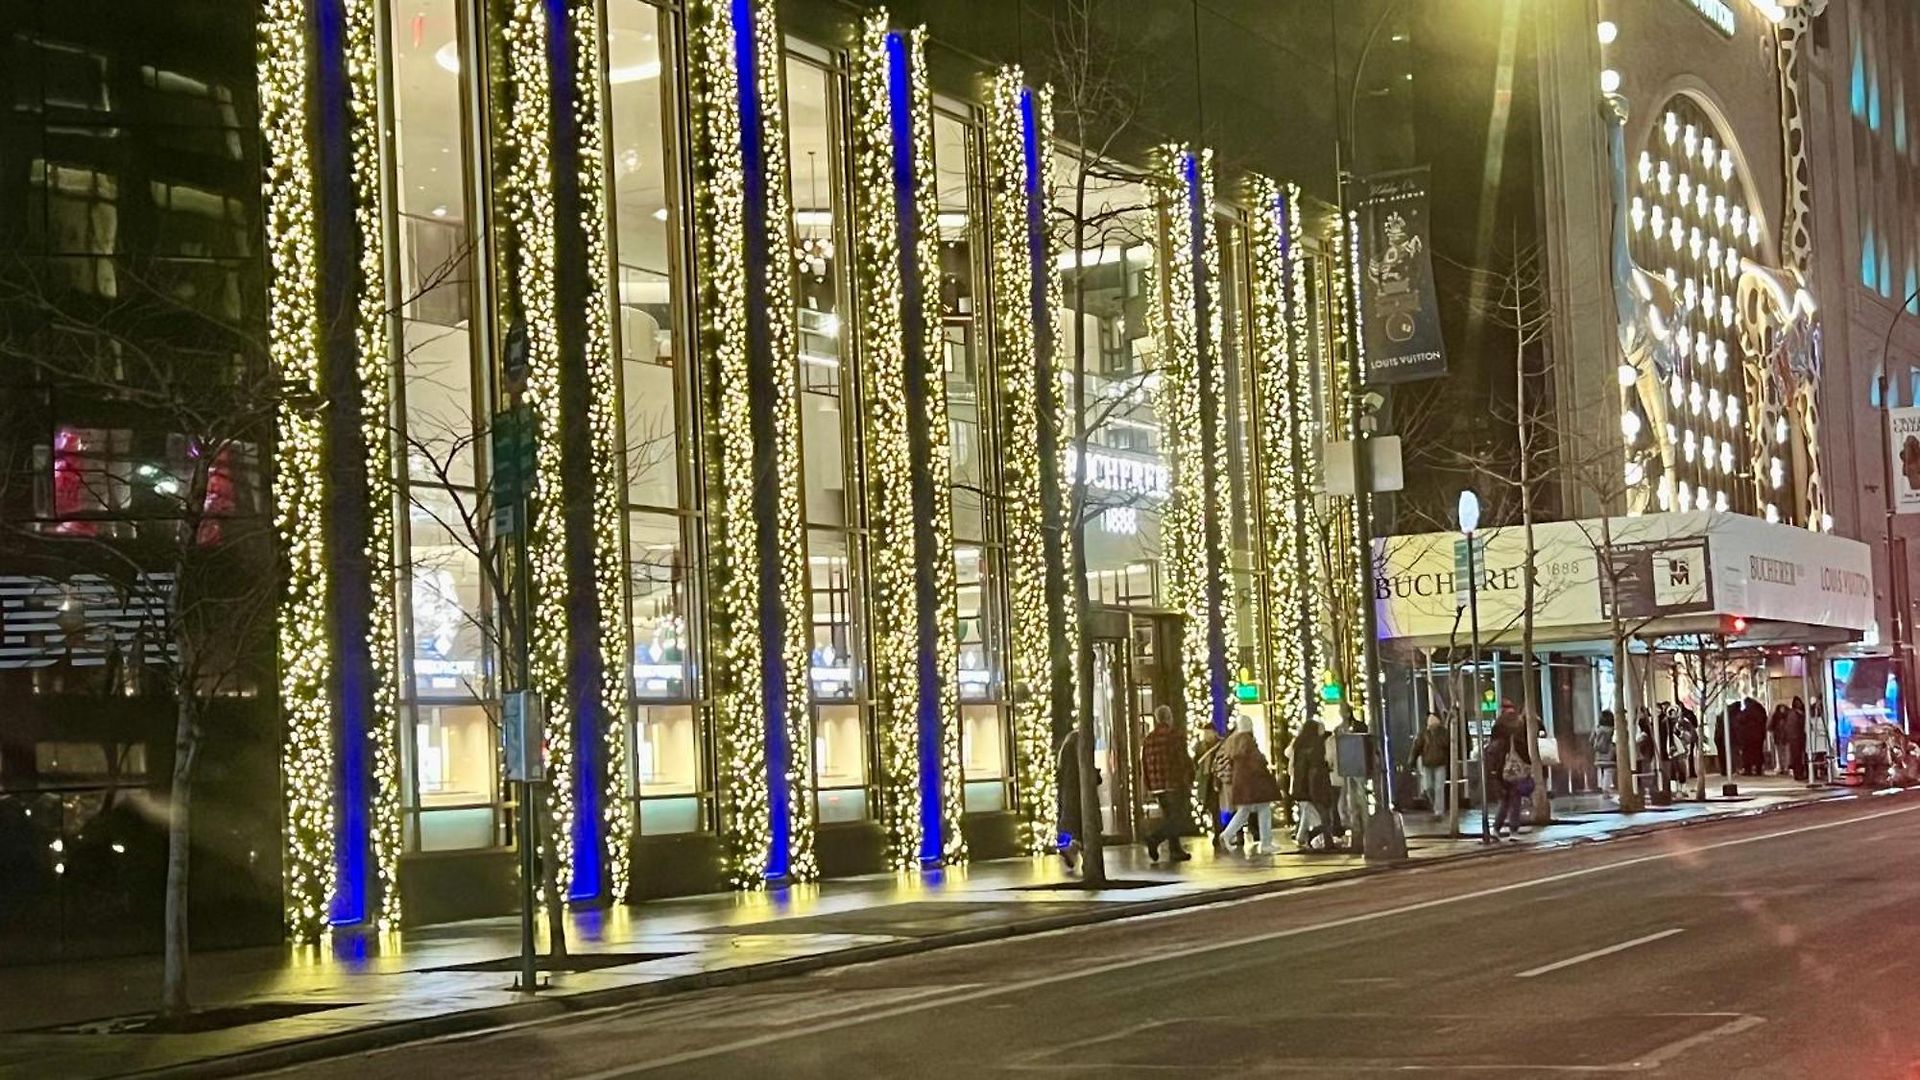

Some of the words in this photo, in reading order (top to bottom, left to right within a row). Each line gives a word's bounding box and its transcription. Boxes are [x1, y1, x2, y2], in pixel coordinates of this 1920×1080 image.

[1370, 357, 1399, 370] LOUIS
[1399, 351, 1441, 364] VUITTON
[1376, 565, 1542, 600] BUCHRER
